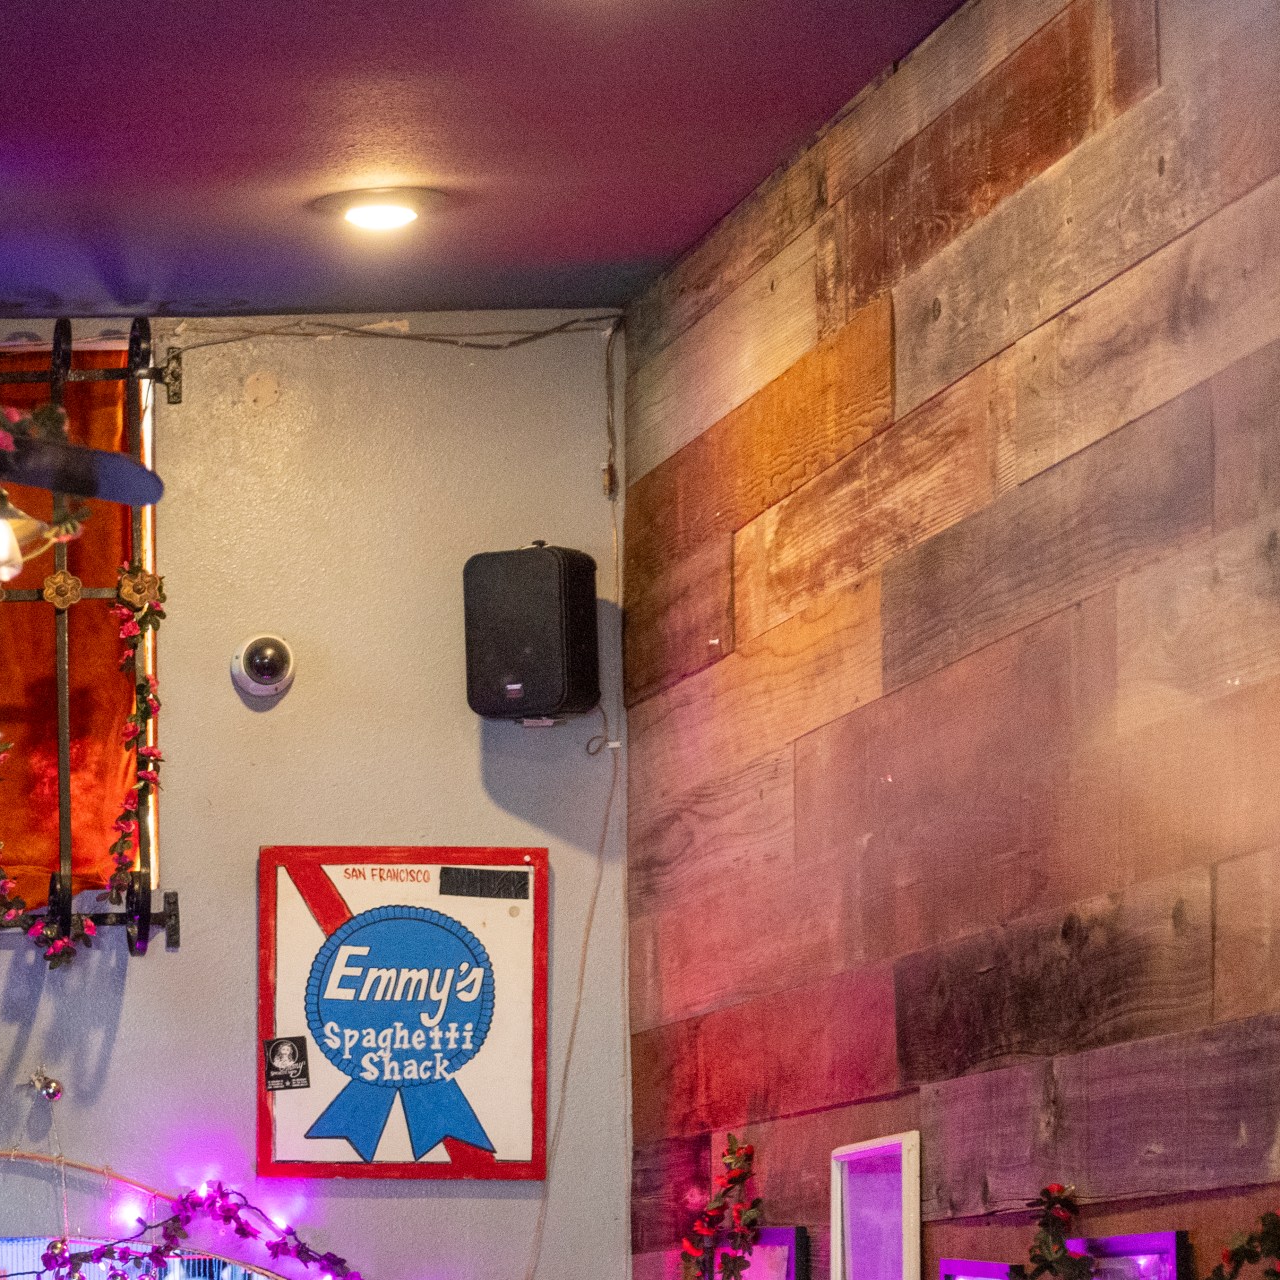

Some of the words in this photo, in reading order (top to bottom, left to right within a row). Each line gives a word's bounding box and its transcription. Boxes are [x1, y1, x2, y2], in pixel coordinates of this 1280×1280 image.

[343, 867, 367, 880] SAN
[371, 868, 431, 883] FRANCISCO
[323, 945, 485, 1027] Emmy's
[324, 1022, 474, 1058] Spaghetti
[359, 1051, 456, 1082] Shack
